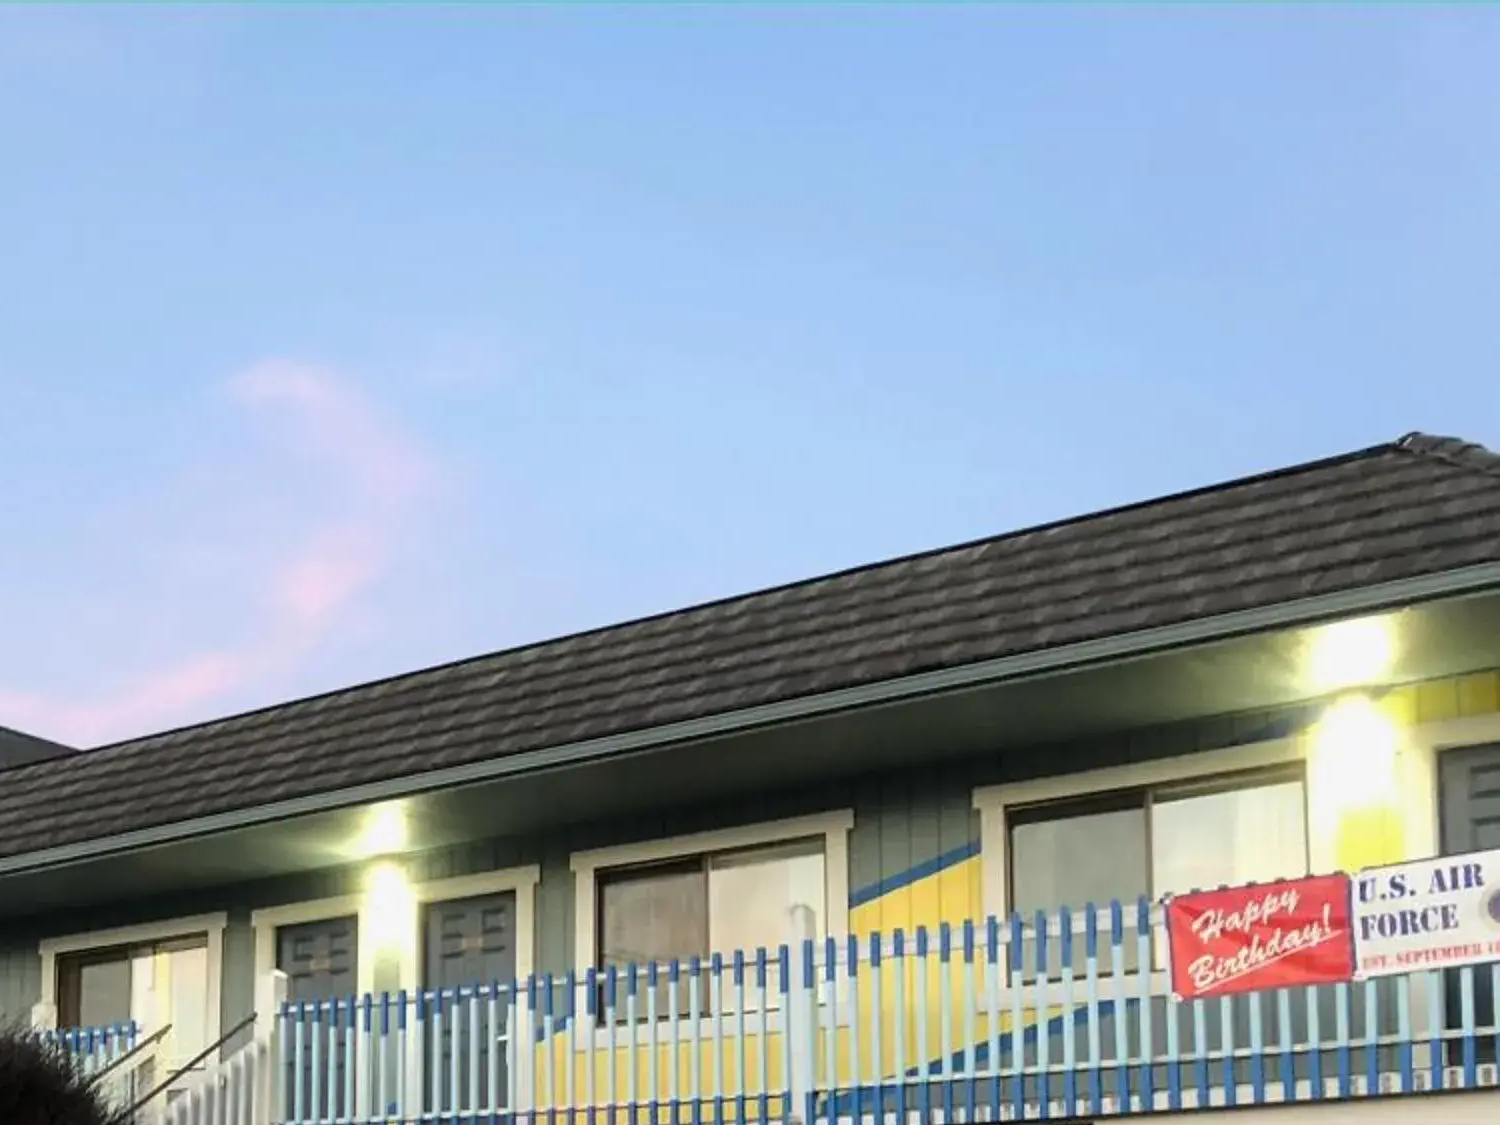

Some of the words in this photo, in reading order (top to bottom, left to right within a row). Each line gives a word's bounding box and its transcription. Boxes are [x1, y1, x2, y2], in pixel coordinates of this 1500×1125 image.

[1359, 874, 1416, 902] U.S.
[1429, 863, 1485, 894] AIR
[1192, 888, 1299, 943] Happy
[1360, 904, 1459, 940] FORCE
[1188, 903, 1331, 988] Birthday!
[1396, 943, 1482, 964] SEPTEMBER
